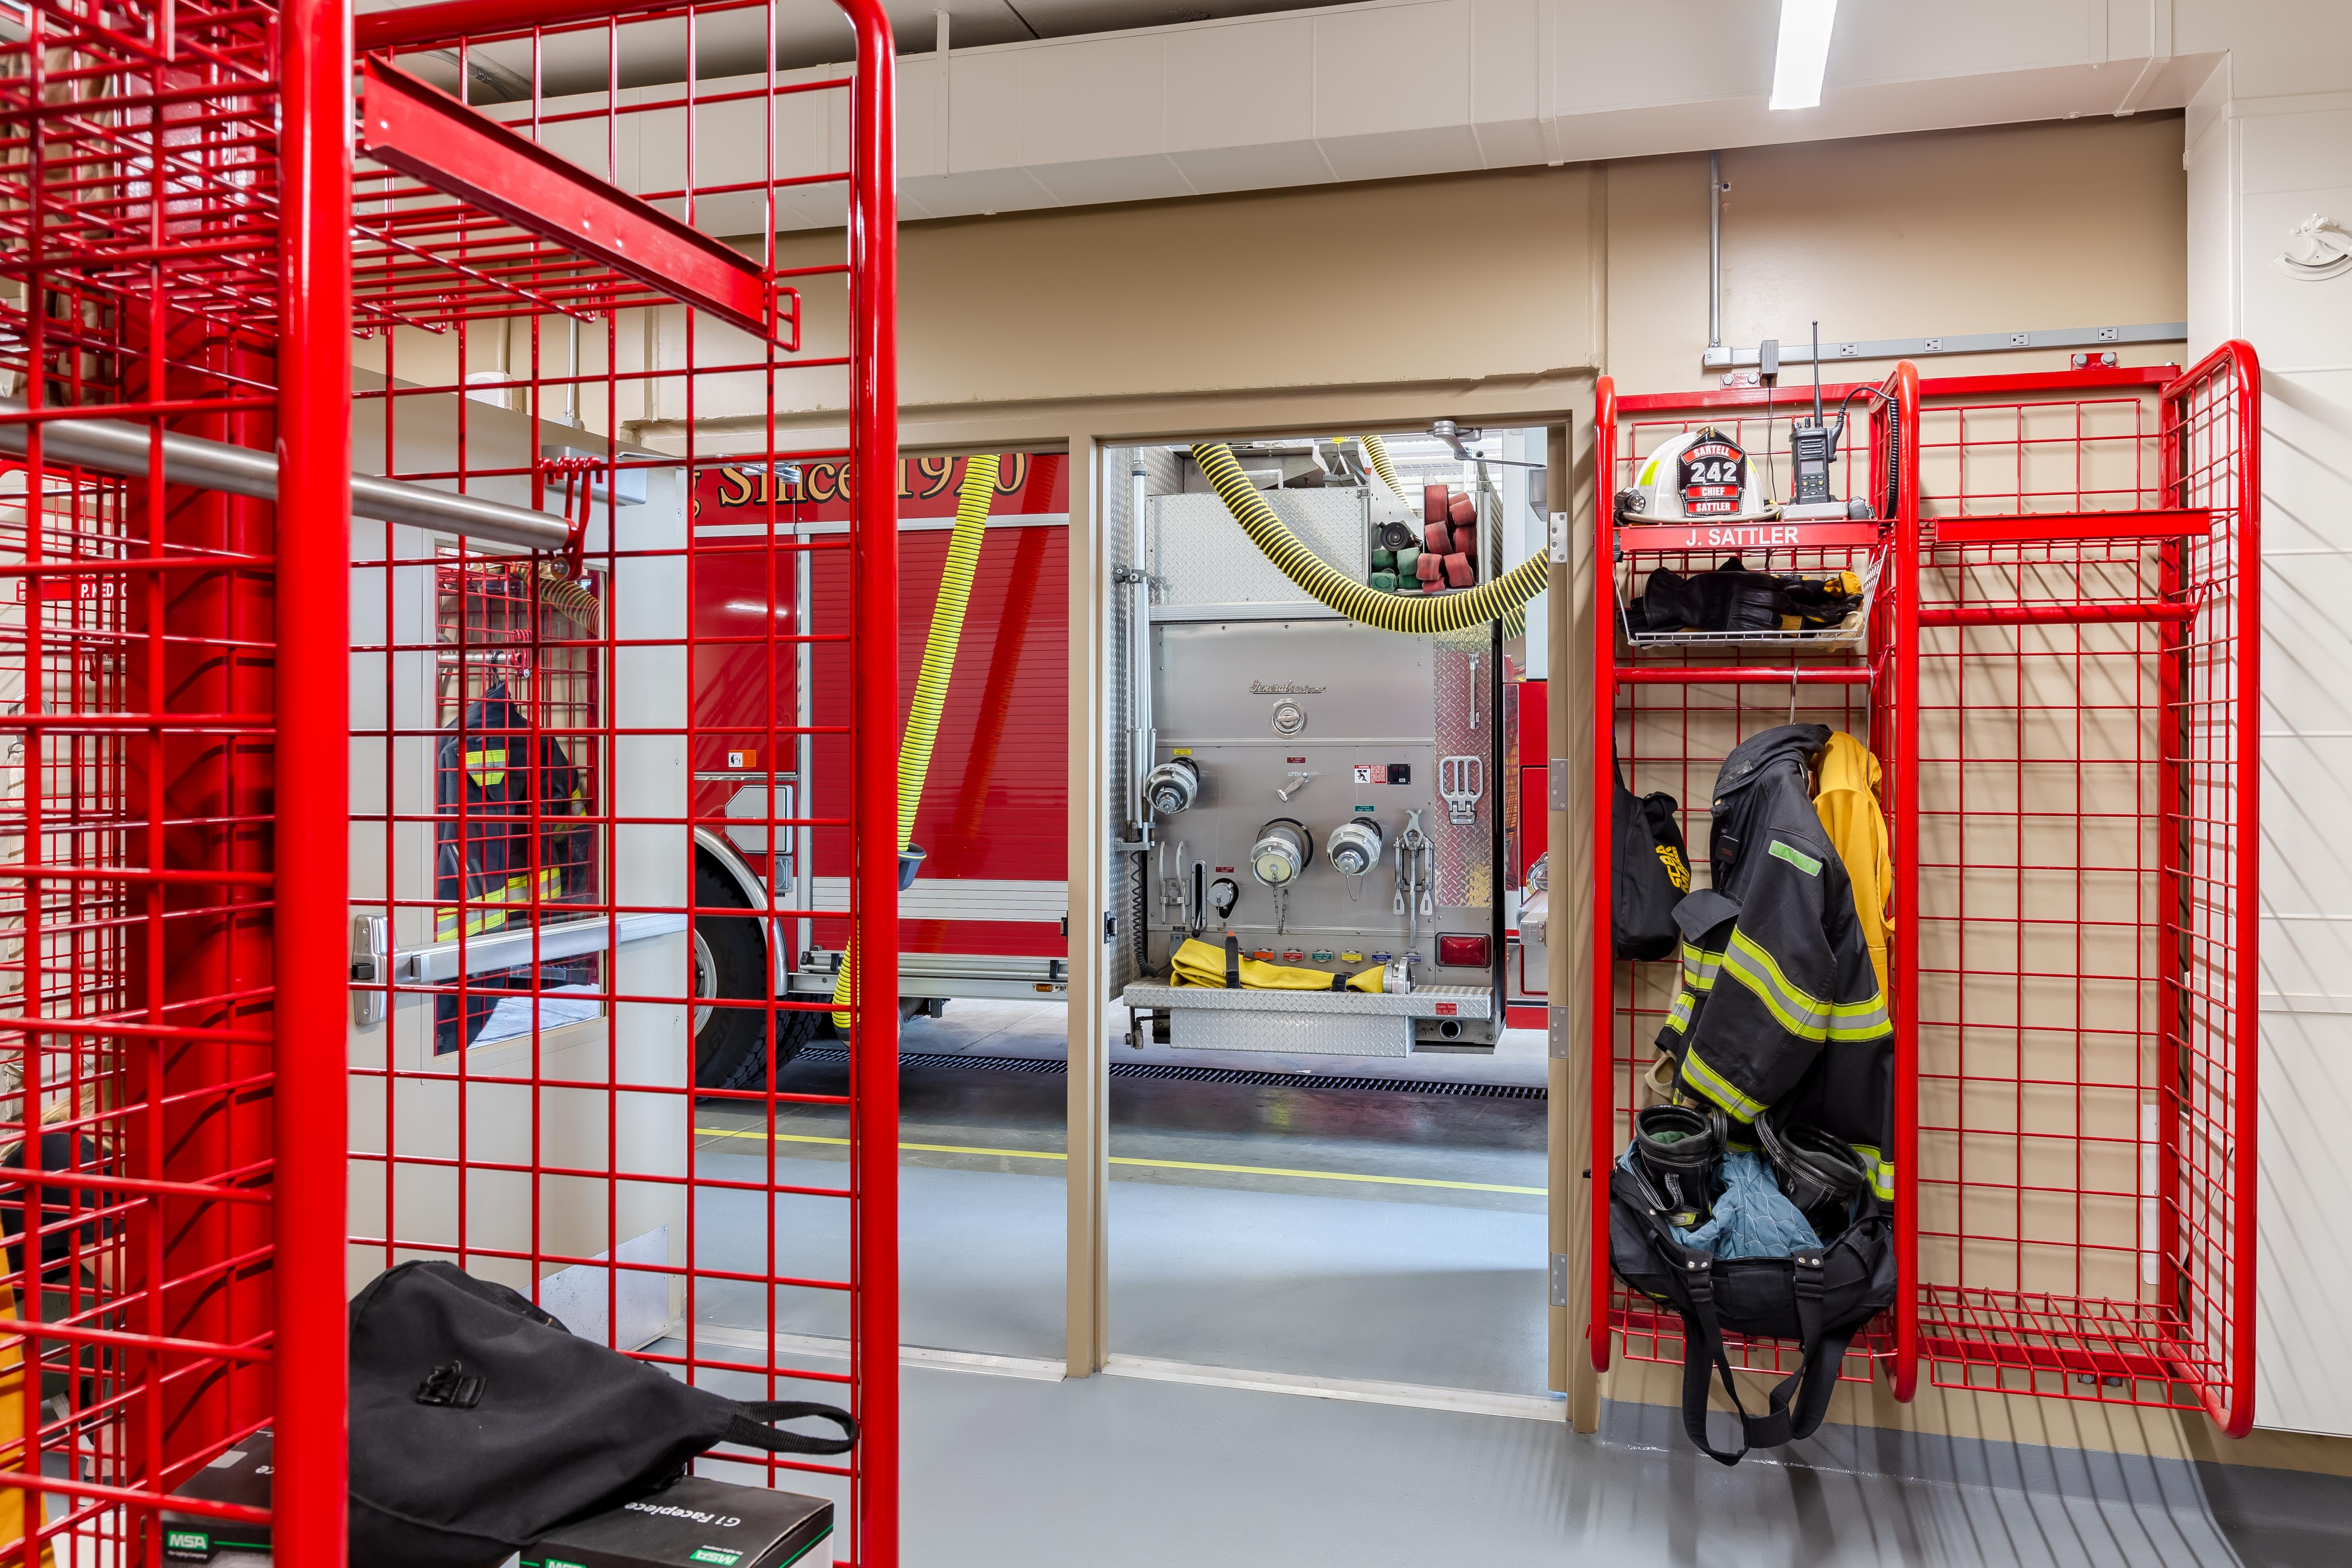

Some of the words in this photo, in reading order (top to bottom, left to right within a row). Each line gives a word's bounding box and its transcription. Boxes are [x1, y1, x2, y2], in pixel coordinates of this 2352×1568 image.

[1693, 445, 1729, 458] SARTELL
[1691, 462, 1737, 483] 242
[1702, 487, 1725, 498] CHIEF
[1696, 502, 1731, 512] SATTLER
[1685, 528, 1702, 546] J.
[1708, 526, 1799, 546] SATTLER
[1249, 679, 1292, 692] General
[1655, 845, 1681, 888] SCBA
[624, 1502, 715, 1523] Facepiece
[715, 1516, 741, 1527] G1
[170, 1533, 206, 1550] MSA
[695, 1551, 736, 1565] MSA
